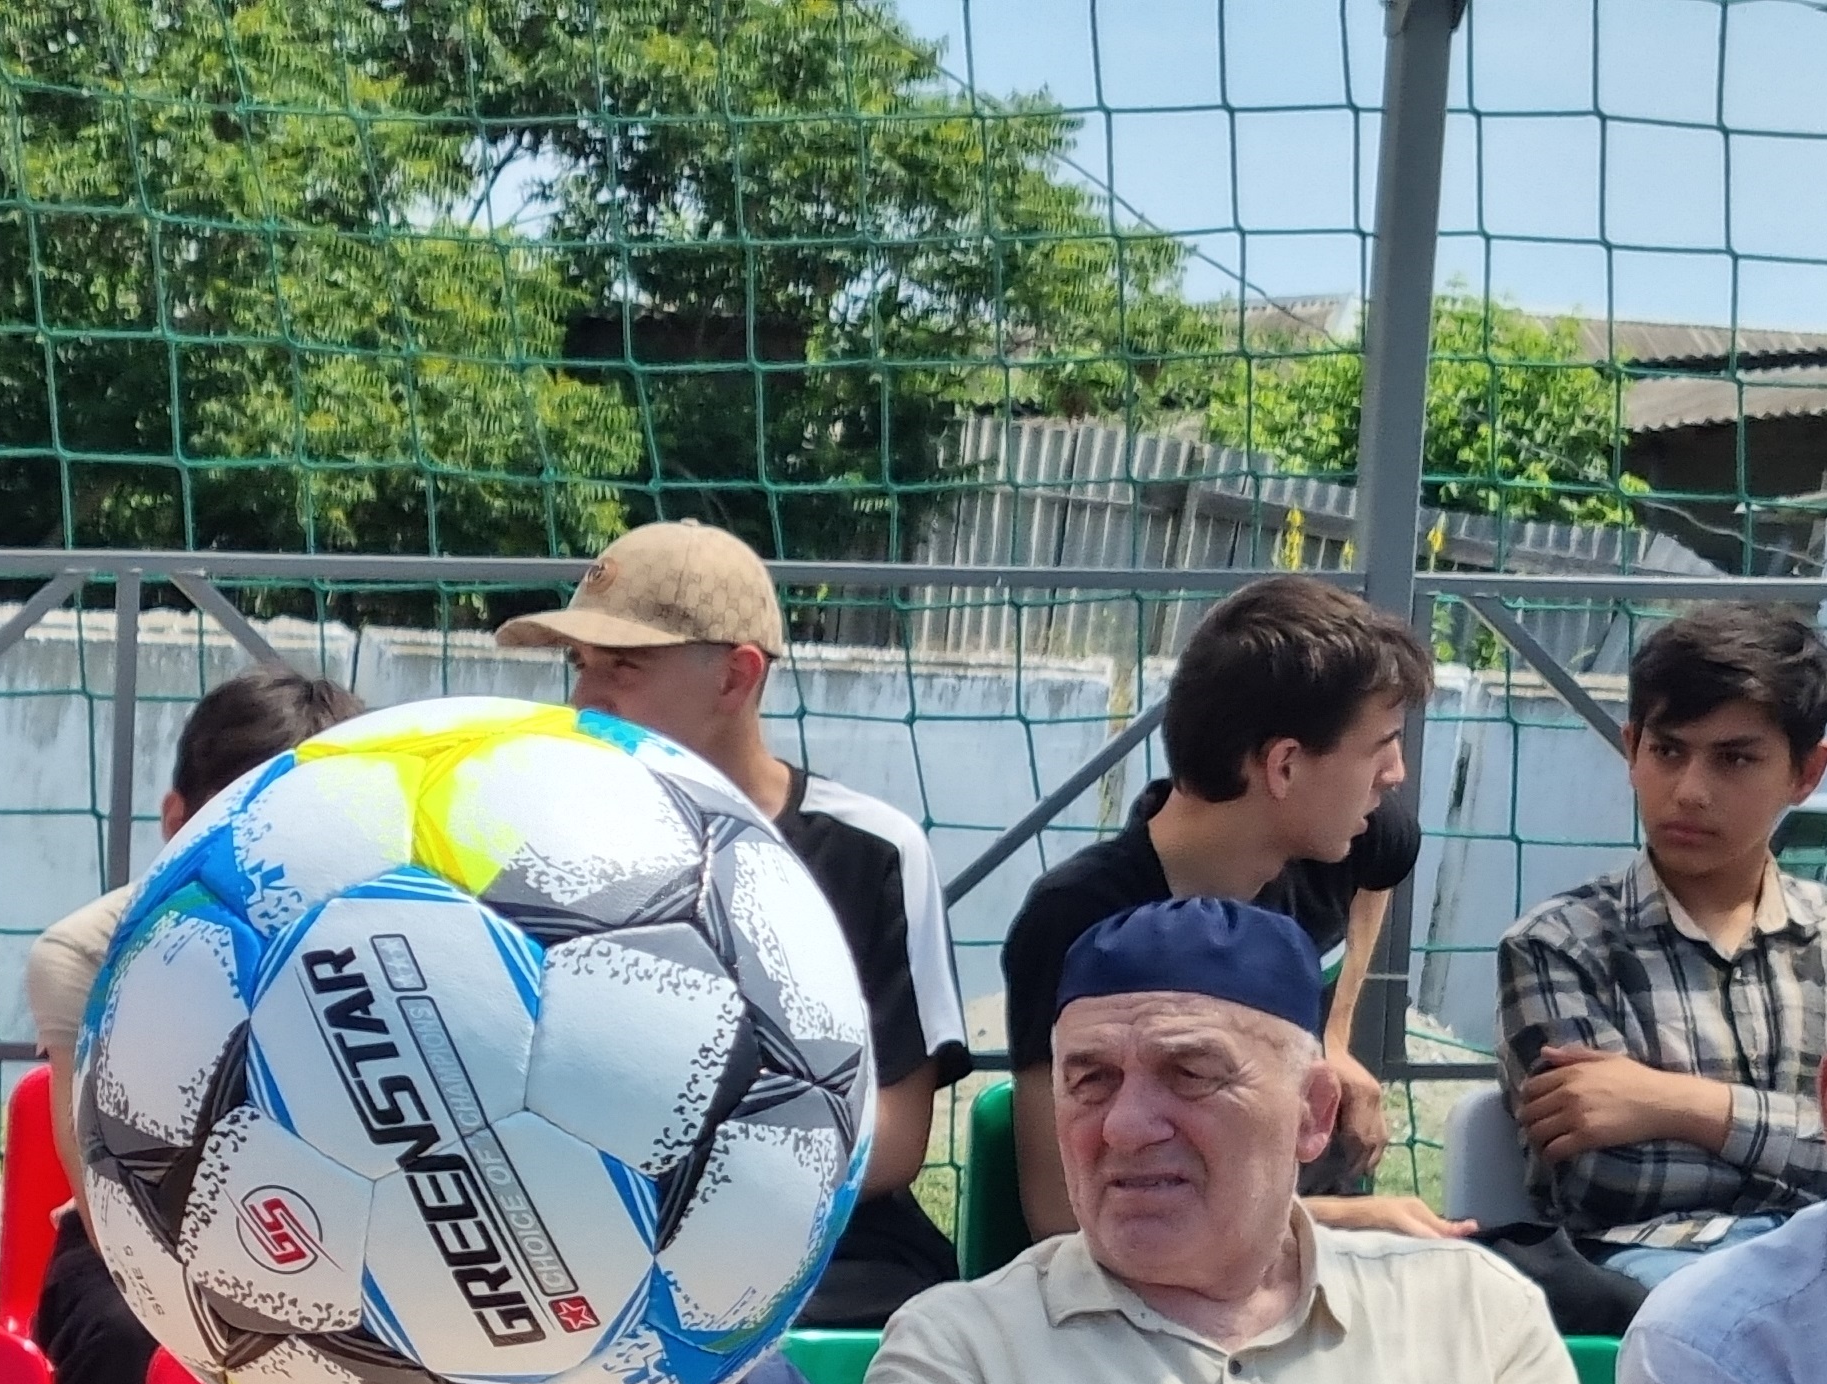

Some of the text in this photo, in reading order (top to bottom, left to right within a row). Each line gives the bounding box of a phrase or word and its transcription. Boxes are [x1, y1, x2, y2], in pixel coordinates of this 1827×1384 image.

[301, 946, 547, 1348] GREENSTAR
[407, 1005, 568, 1288] CHOICE OF CHAMPIONS
